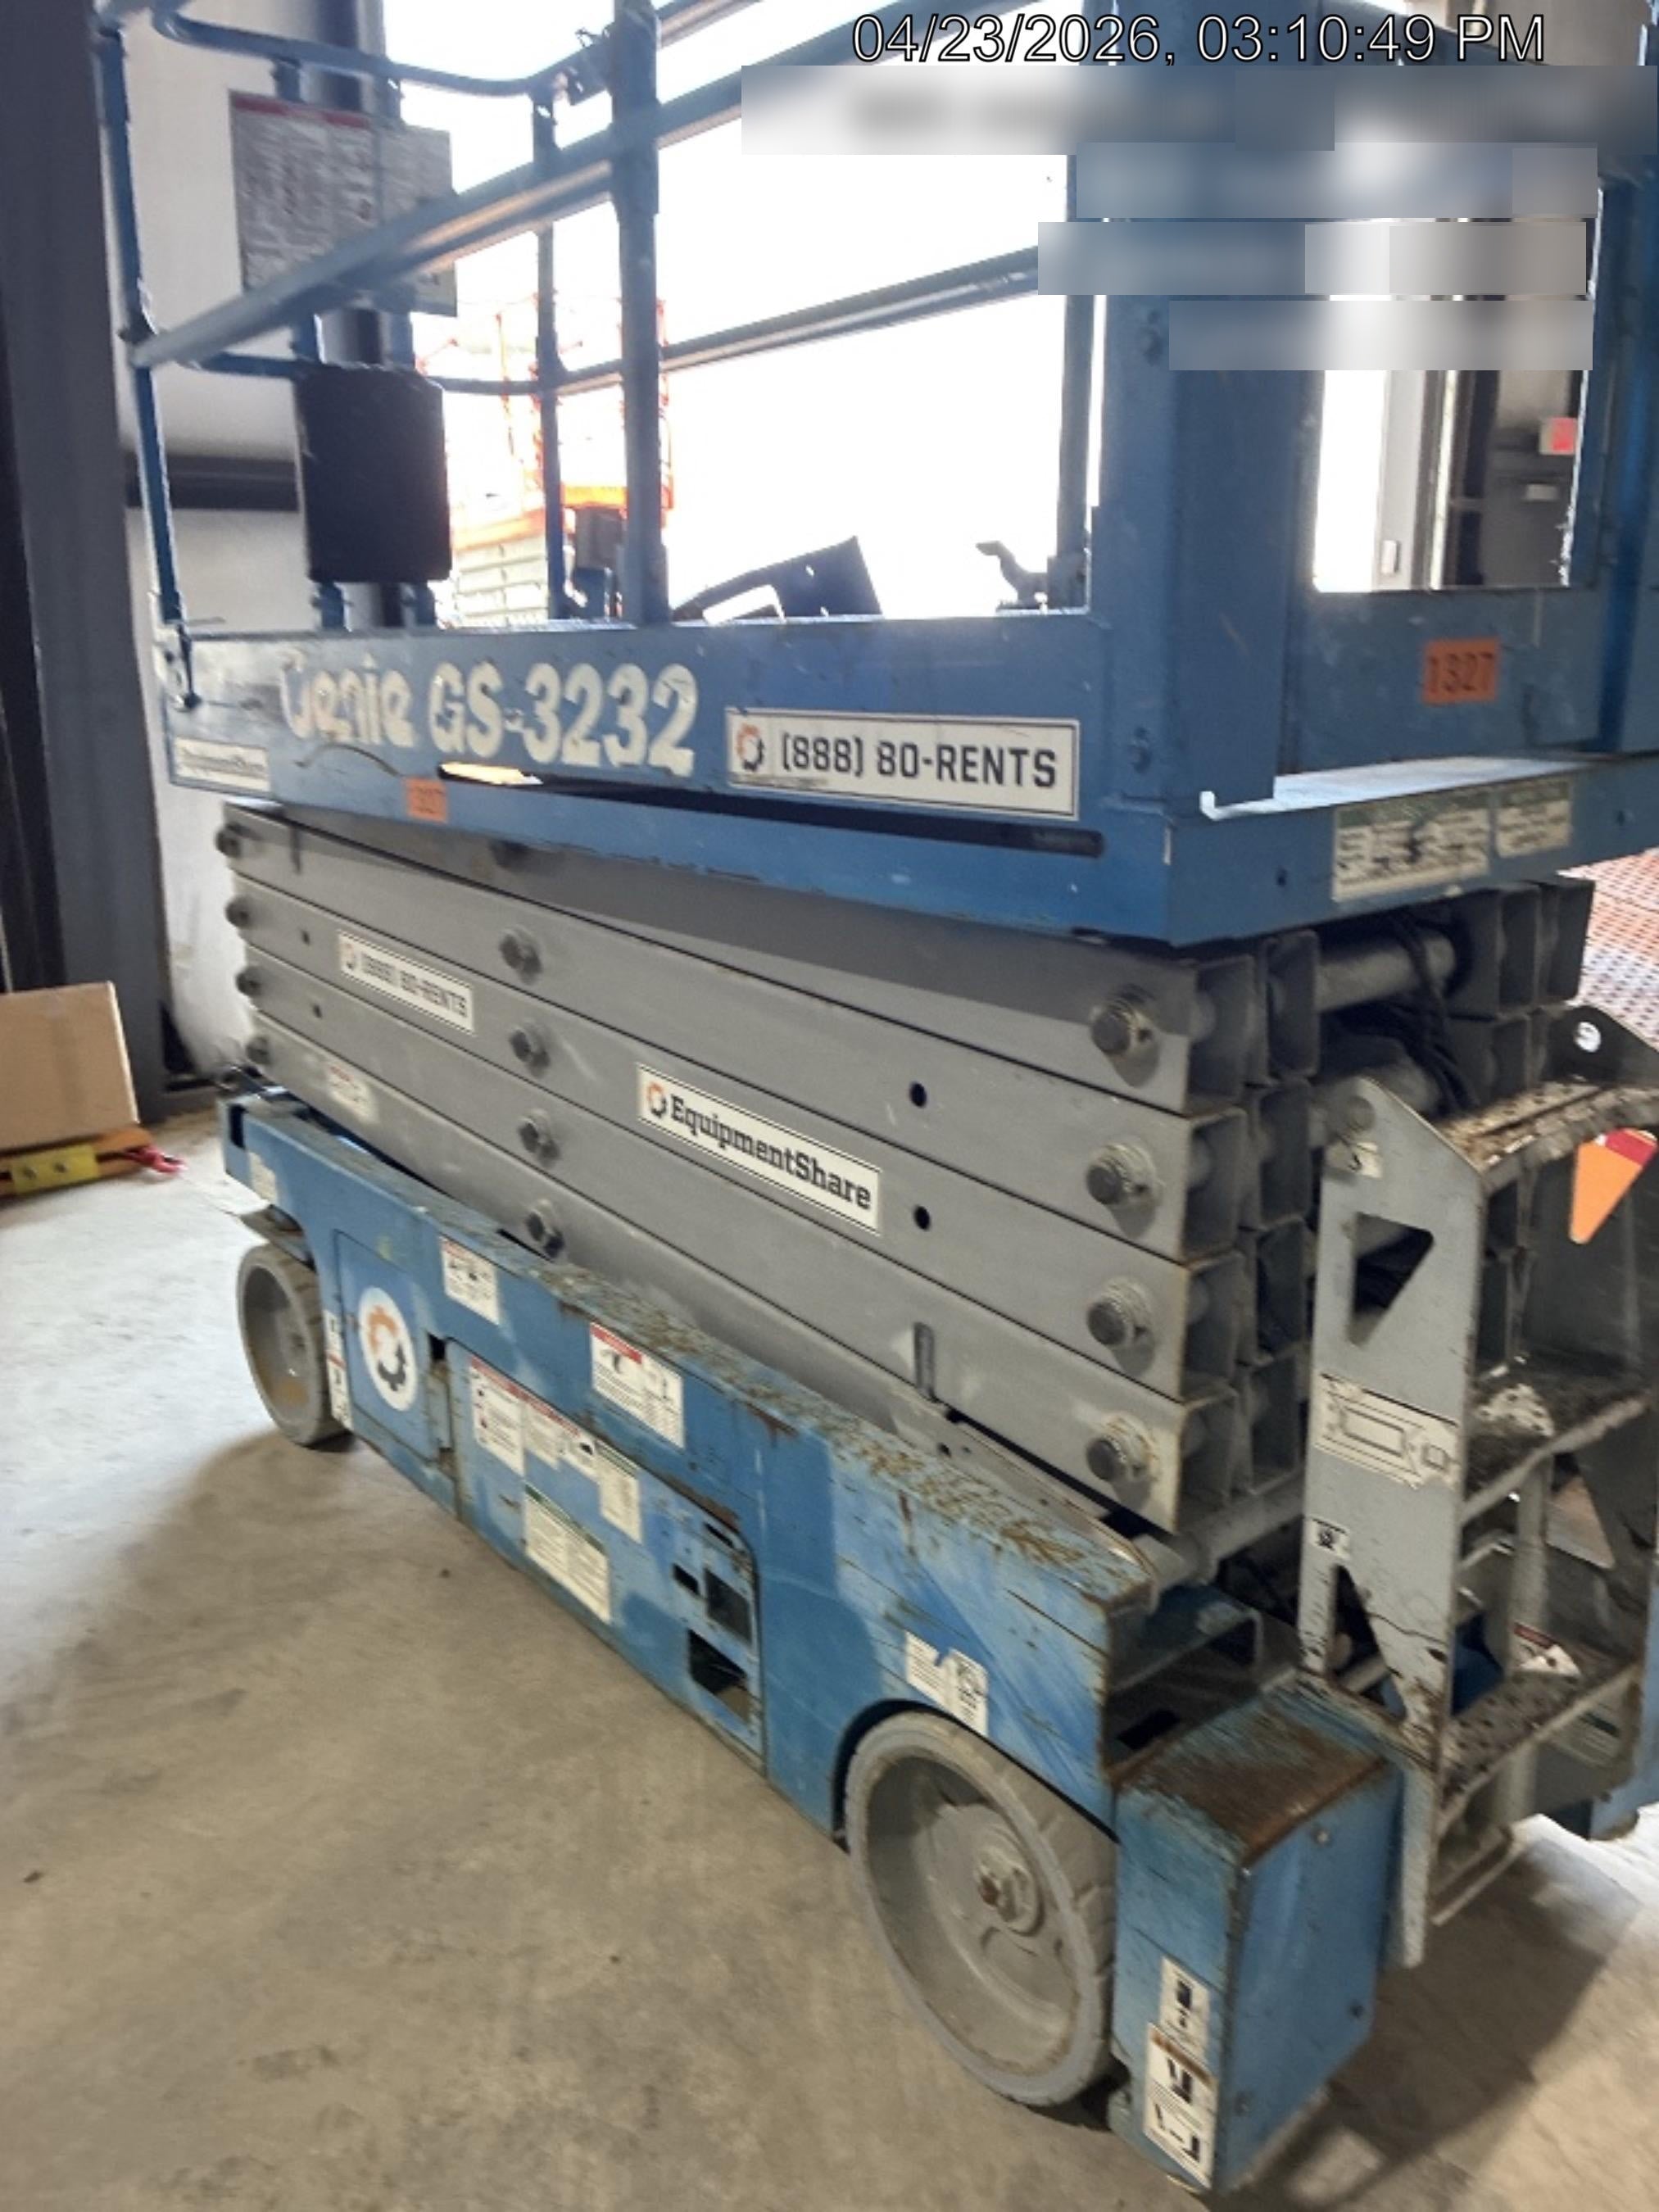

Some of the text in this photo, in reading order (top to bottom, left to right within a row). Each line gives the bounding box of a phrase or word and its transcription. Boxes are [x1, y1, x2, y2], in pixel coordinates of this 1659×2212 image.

[428, 660, 696, 777] GS-3232
[877, 741, 1057, 788] 80-RENTS
[670, 1093, 872, 1210] EquipmentShare
